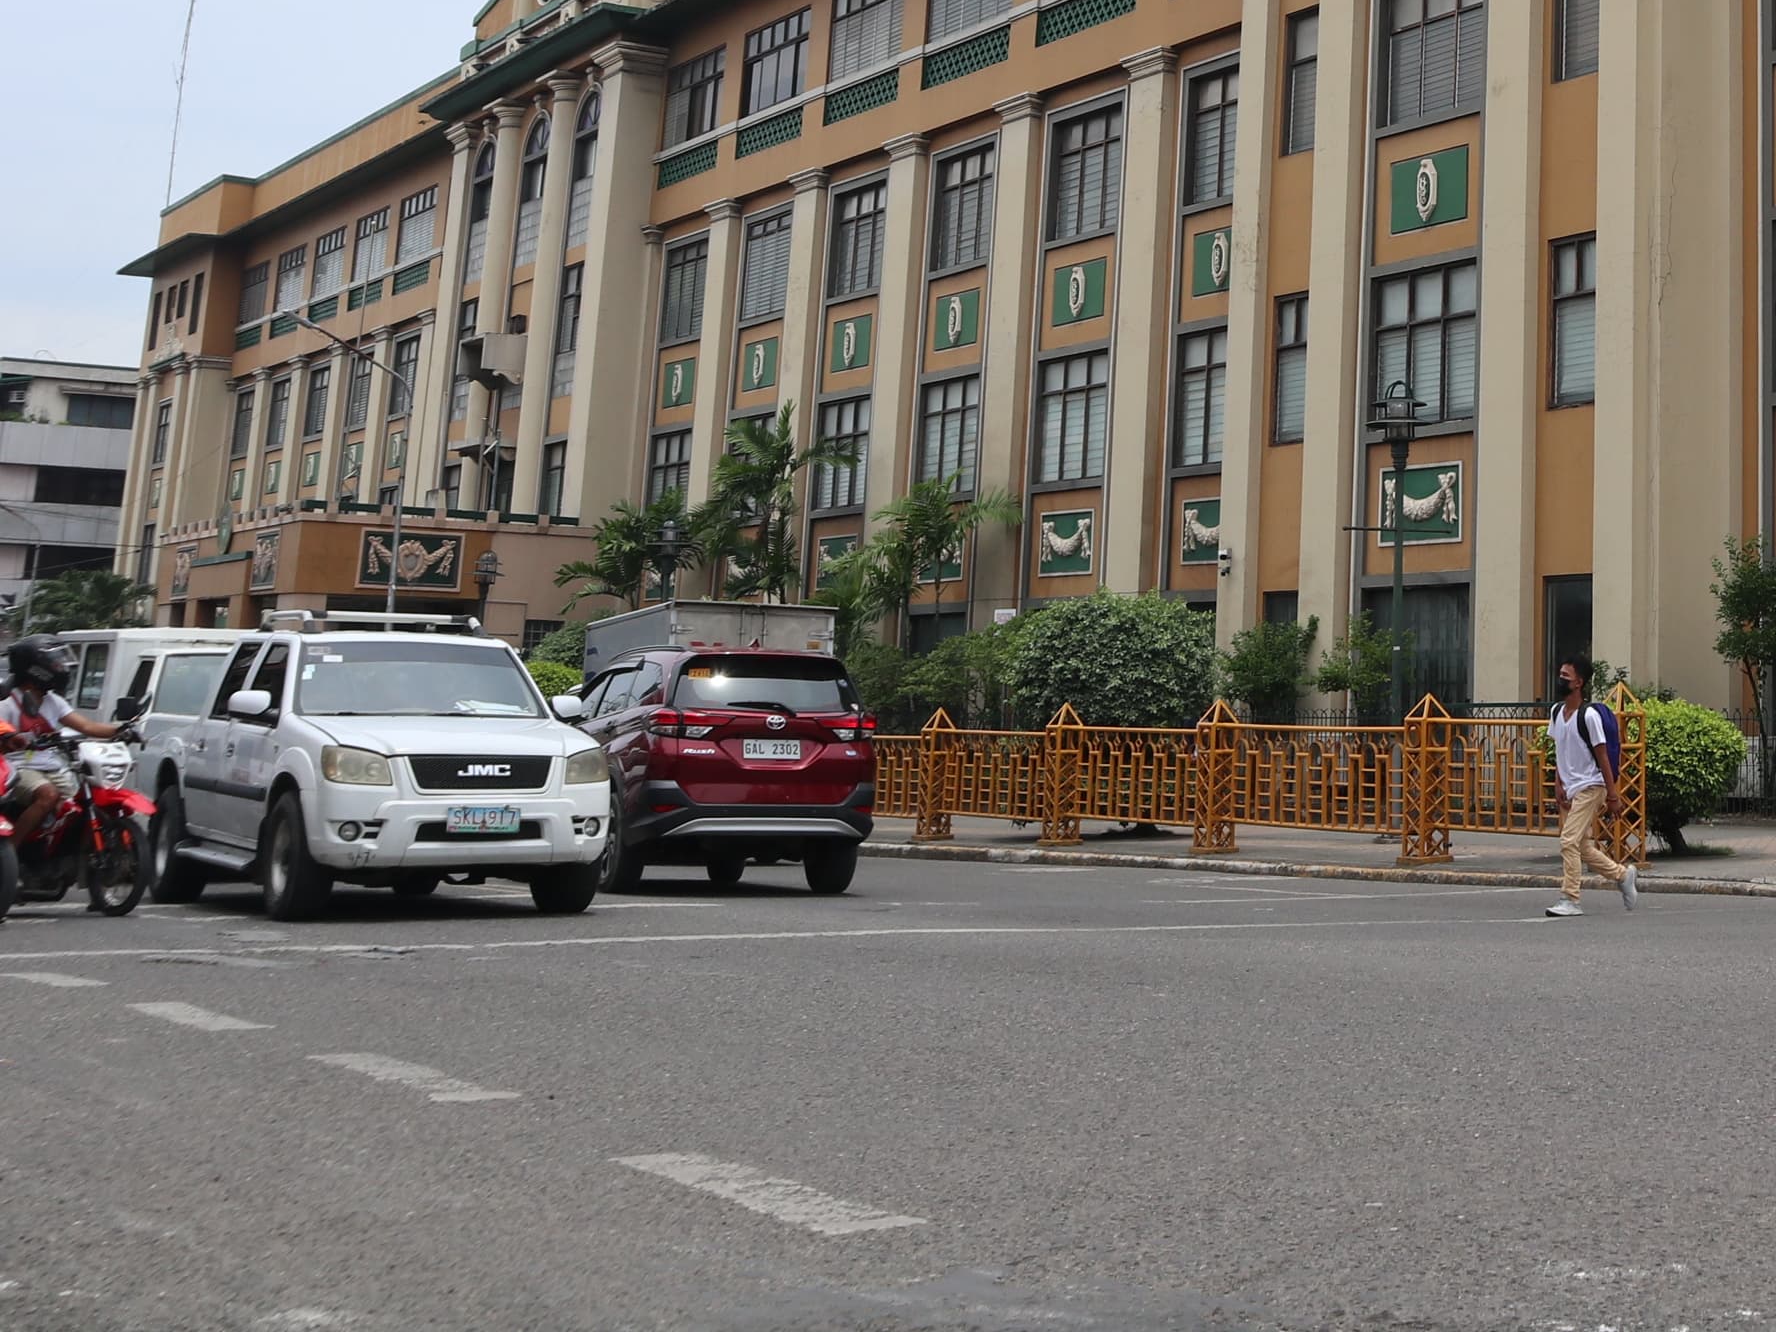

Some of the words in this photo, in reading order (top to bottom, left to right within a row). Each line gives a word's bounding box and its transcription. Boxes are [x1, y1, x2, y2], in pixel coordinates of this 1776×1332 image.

[744, 742, 765, 754] GAL
[772, 742, 799, 754] 2302
[457, 764, 511, 776] JMC
[454, 810, 480, 825] SKL
[489, 810, 516, 825] 917
